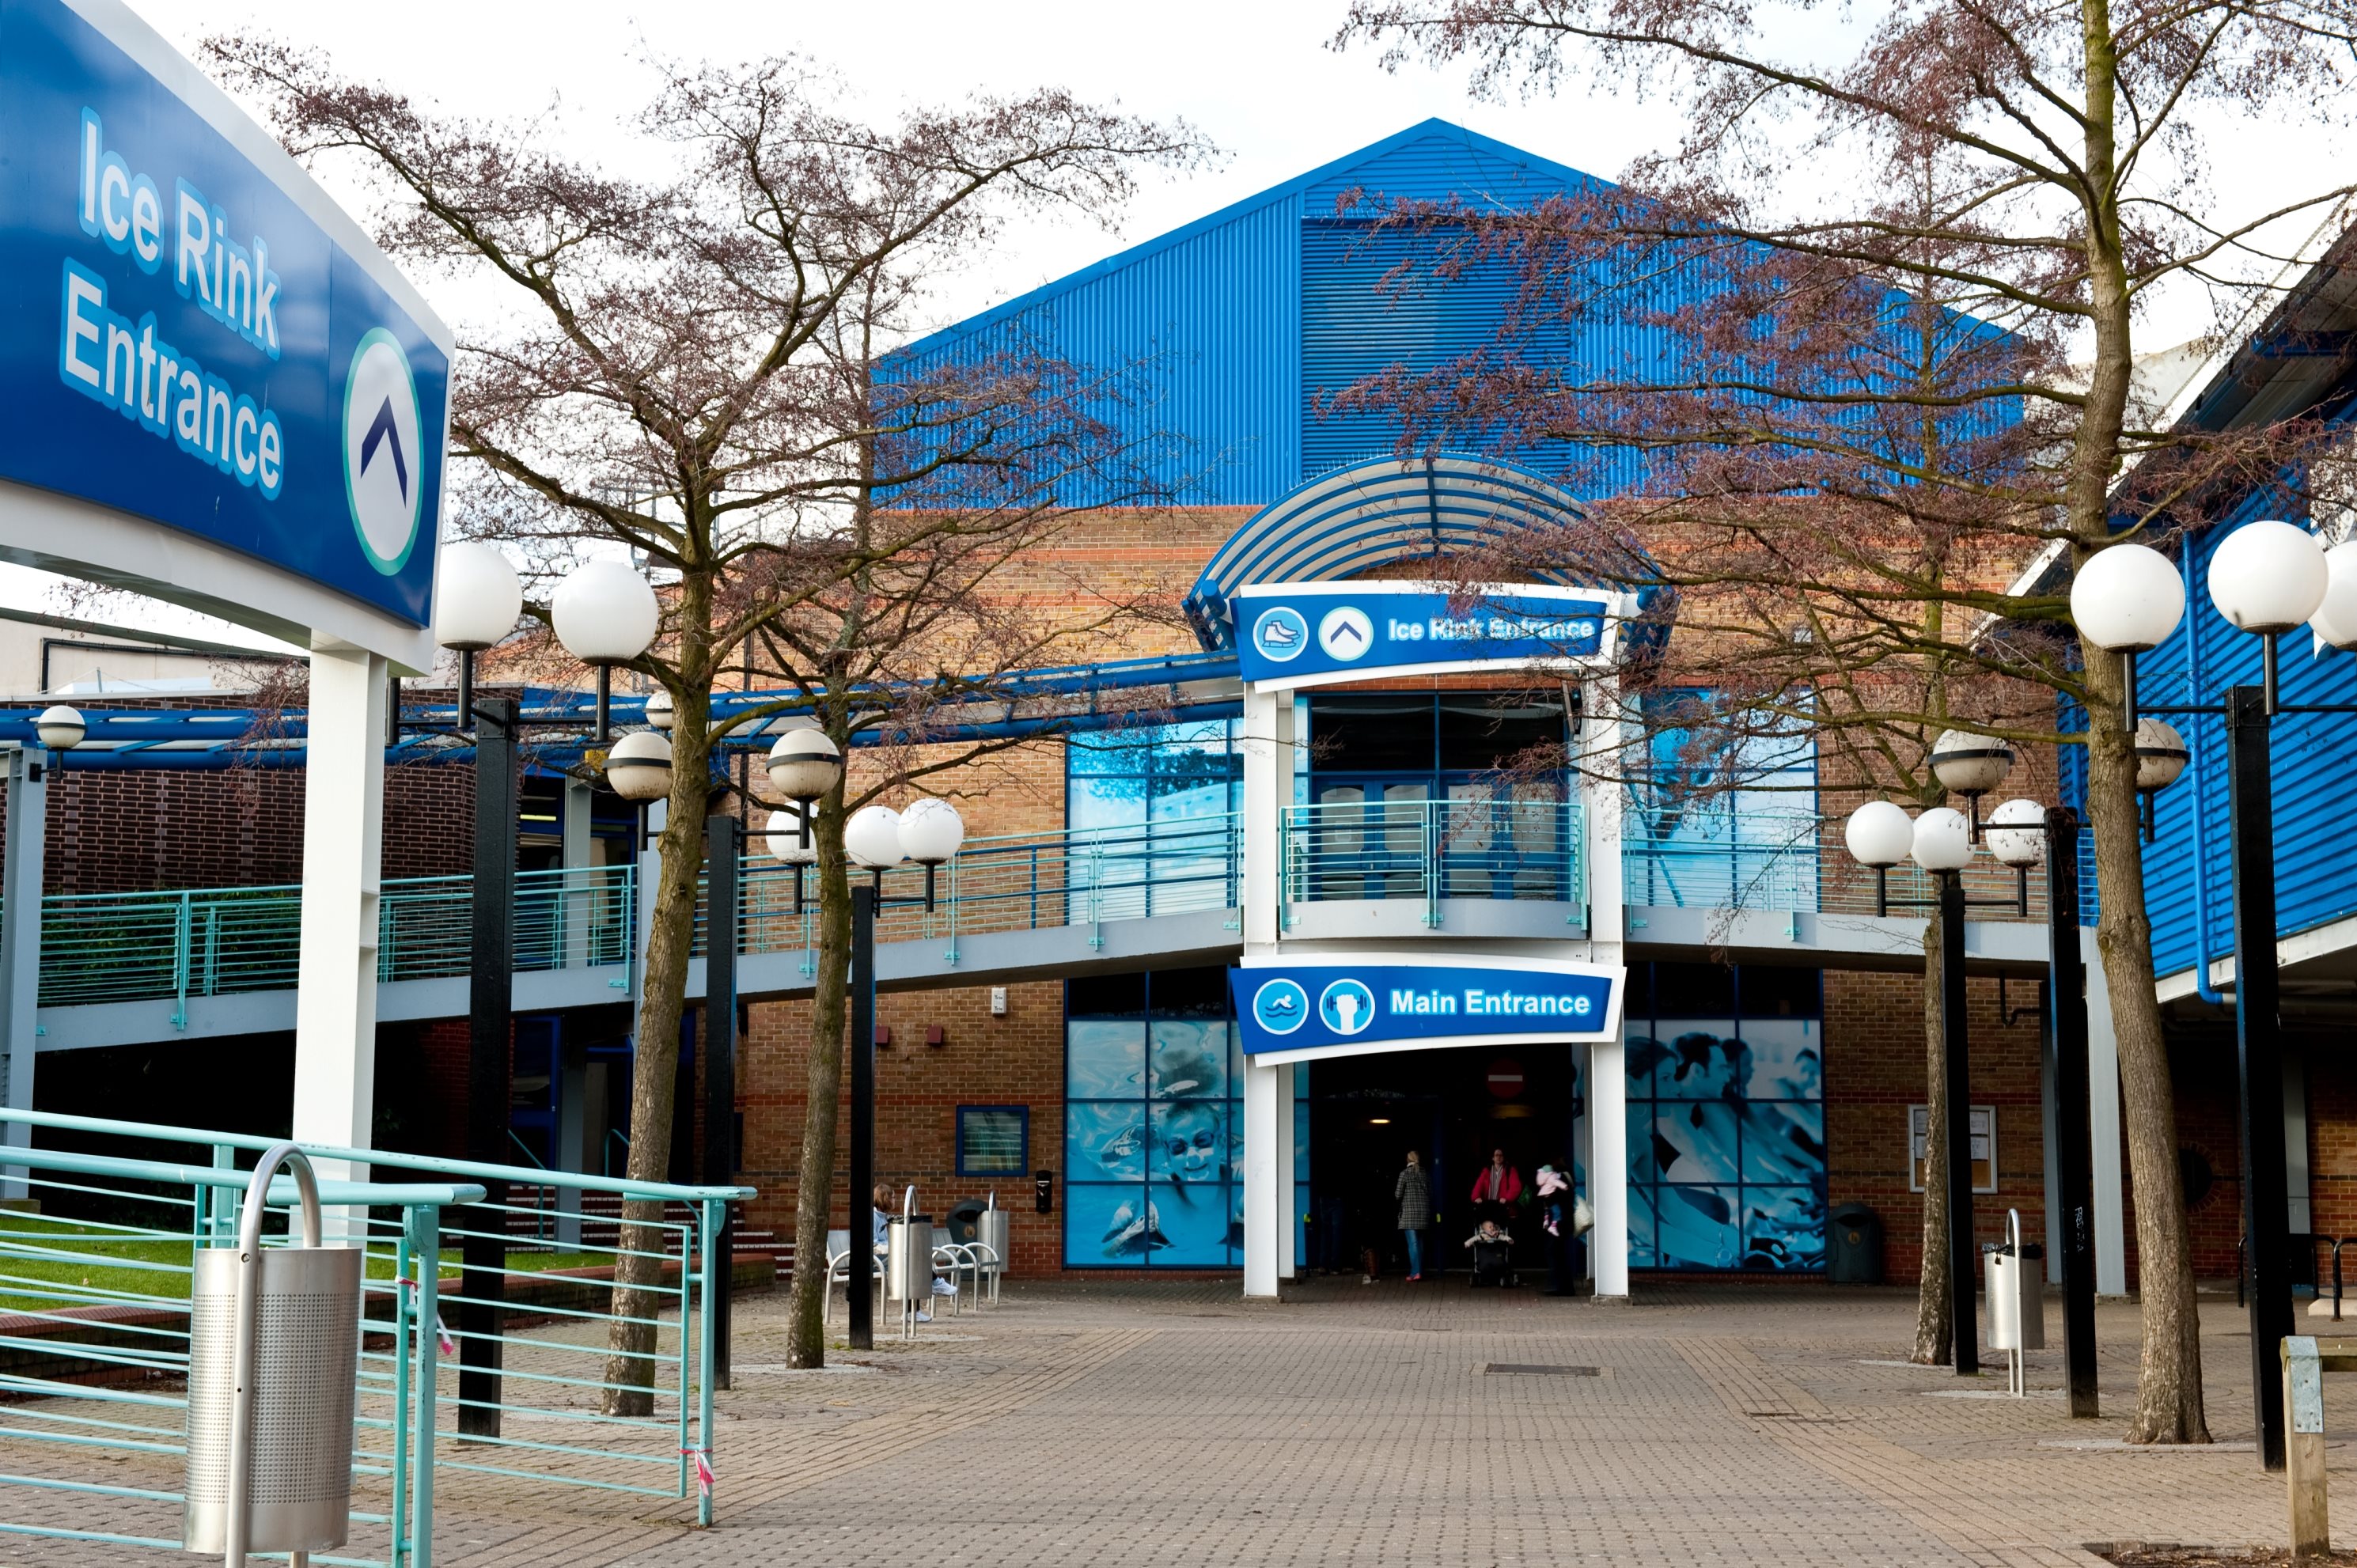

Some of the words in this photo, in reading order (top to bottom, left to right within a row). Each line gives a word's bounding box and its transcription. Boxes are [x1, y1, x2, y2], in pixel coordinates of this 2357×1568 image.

[82, 117, 162, 264] Ice
[176, 187, 279, 351] Rink
[63, 269, 282, 490] Entrance
[1389, 619, 1423, 639] Ice
[1488, 617, 1593, 638] Entrance
[1392, 990, 1457, 1014] Main
[1465, 990, 1591, 1014] Entrance
